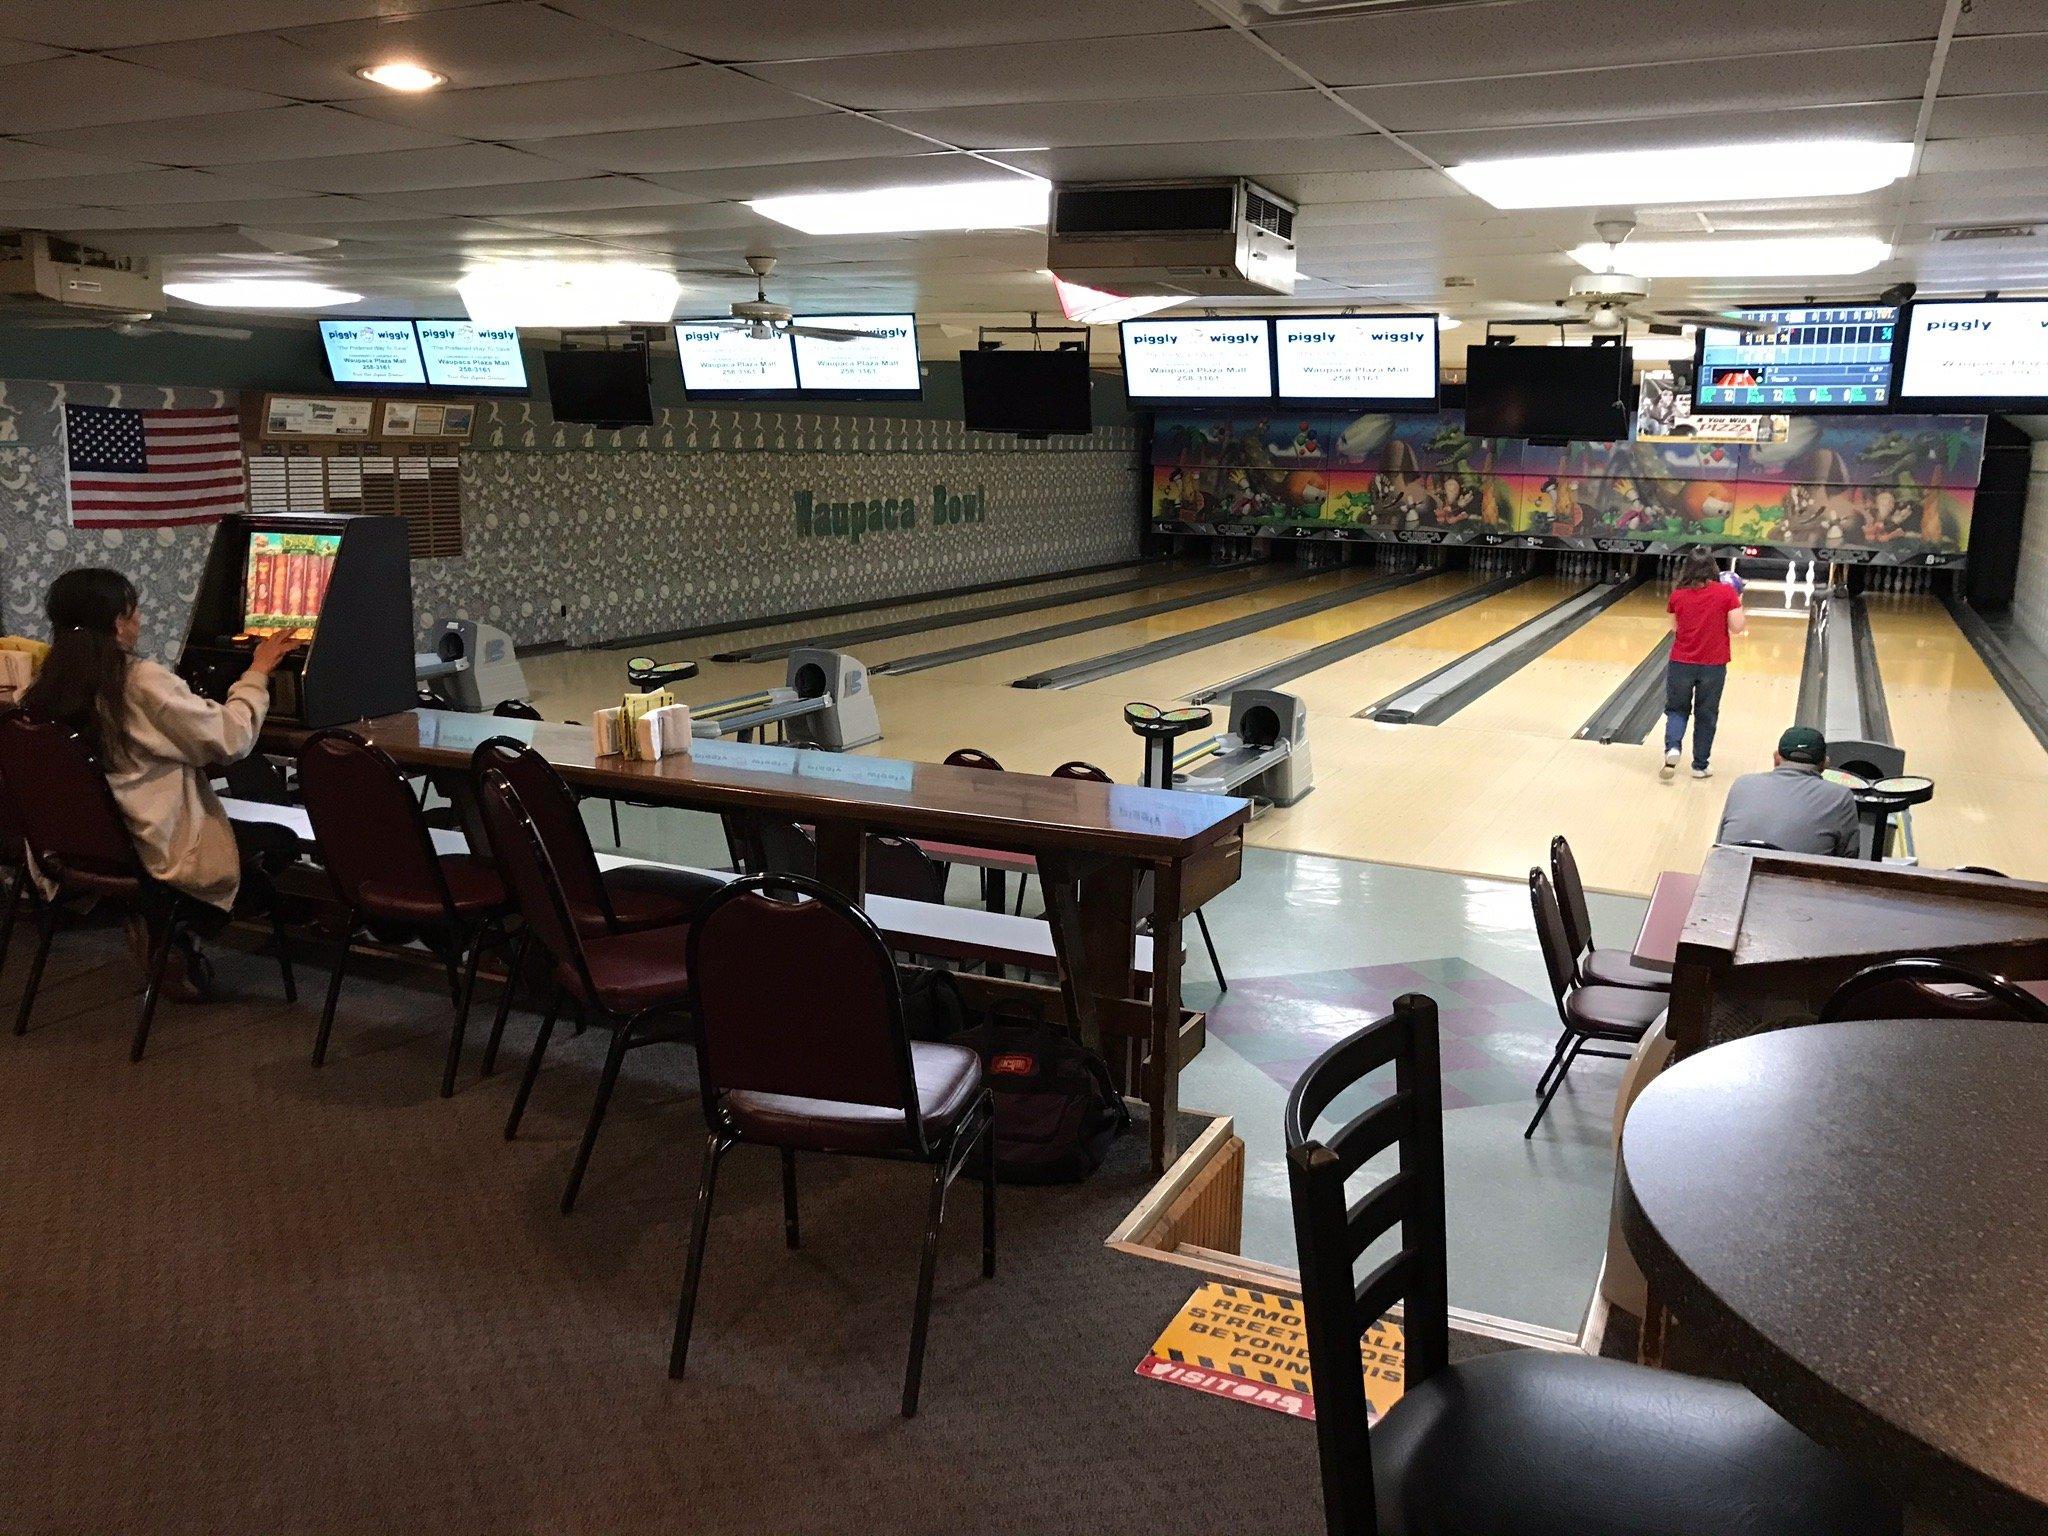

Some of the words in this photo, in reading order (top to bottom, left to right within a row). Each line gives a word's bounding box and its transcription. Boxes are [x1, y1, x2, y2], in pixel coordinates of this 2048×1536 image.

[1927, 319, 1992, 331] piggly
[328, 330, 358, 340] piggly
[377, 330, 410, 340] wiggly
[422, 329, 455, 339] piggly
[478, 330, 514, 340] wiggly
[685, 331, 720, 341] piggly
[744, 329, 784, 339] wly
[1133, 333, 1178, 344] piggly
[1209, 332, 1259, 344] wiggly
[1287, 332, 1336, 343] piggly
[1371, 331, 1425, 343] wiggly
[1699, 423, 1752, 432] PIZZA
[1212, 1298, 1302, 1327] REMO
[1187, 1307, 1305, 1341] STREET
[1188, 1322, 1309, 1359] BEYOND
[1230, 1347, 1310, 1376] POIN
[1150, 1361, 1303, 1415] VISITORS
